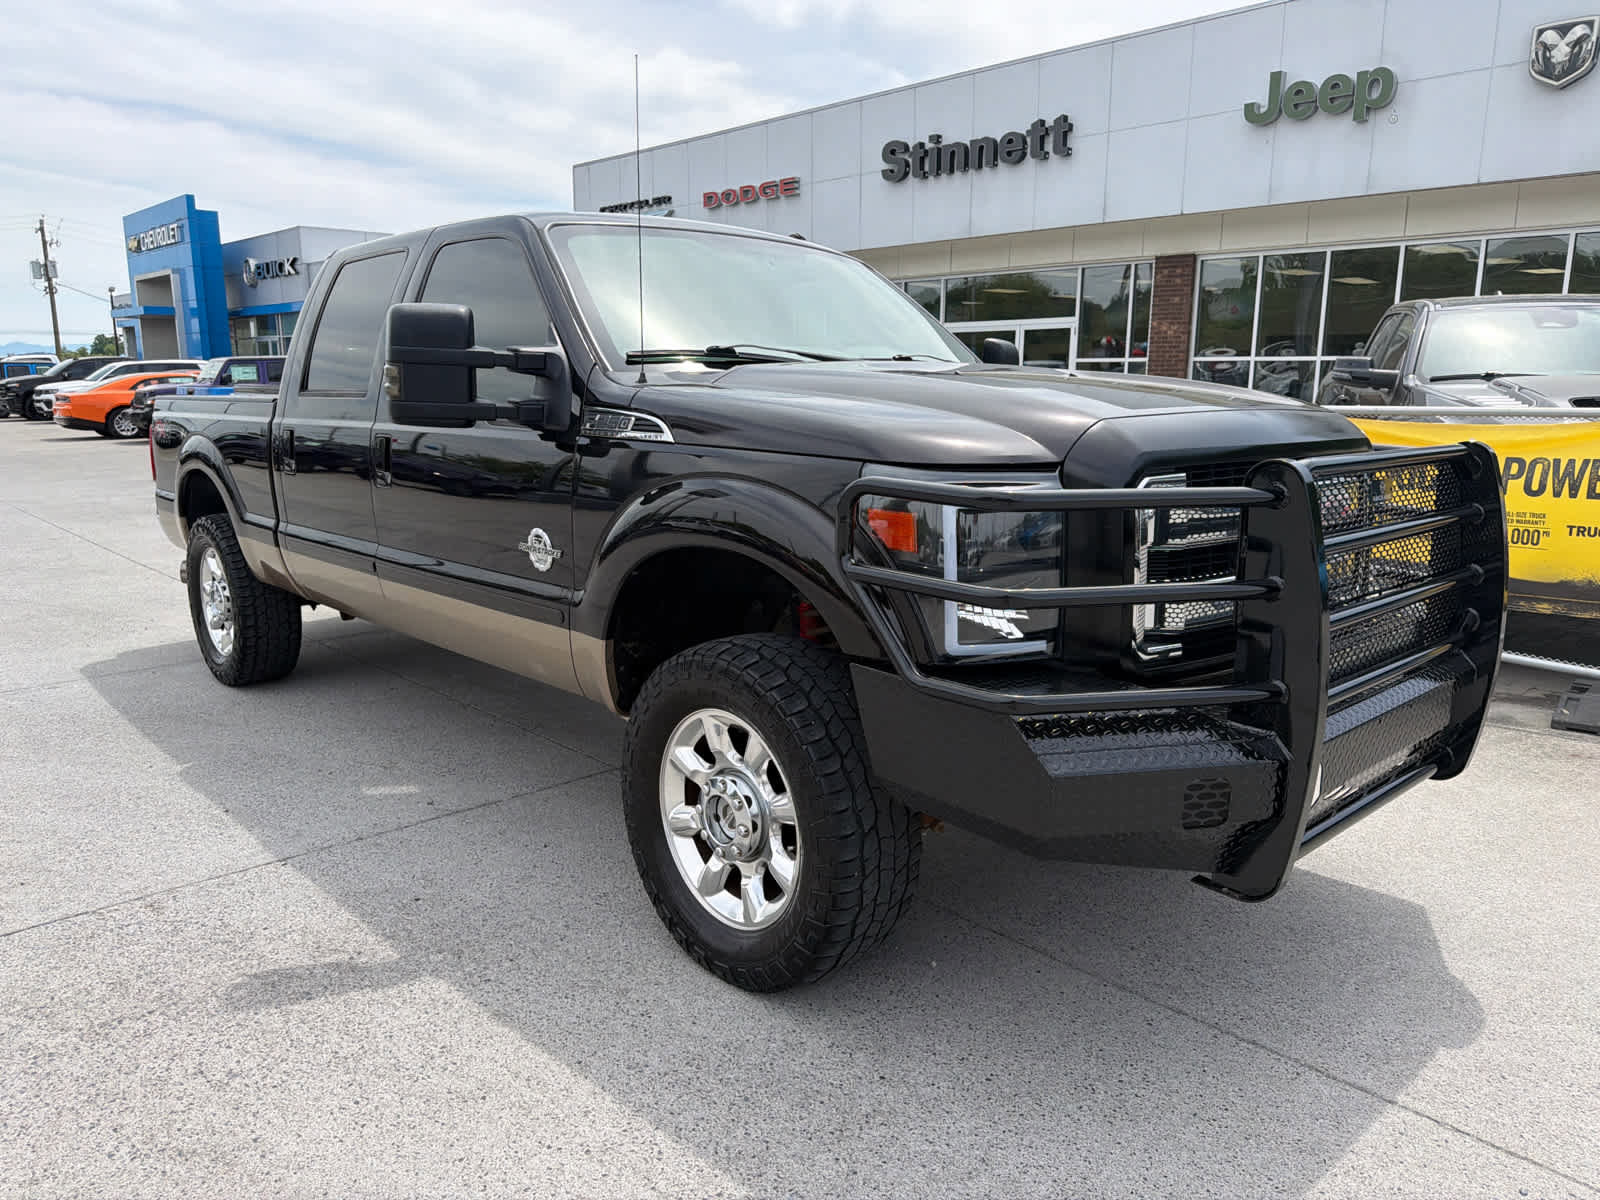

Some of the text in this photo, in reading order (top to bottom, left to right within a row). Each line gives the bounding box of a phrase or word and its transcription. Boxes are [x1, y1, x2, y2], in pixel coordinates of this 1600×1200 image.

[1243, 66, 1398, 126] Jeep
[881, 113, 1074, 184] Stinnett
[702, 176, 800, 210] DODGE
[140, 223, 180, 251] CHEVROLET
[255, 256, 299, 281] BUICK
[1566, 525, 1600, 538] TRU
